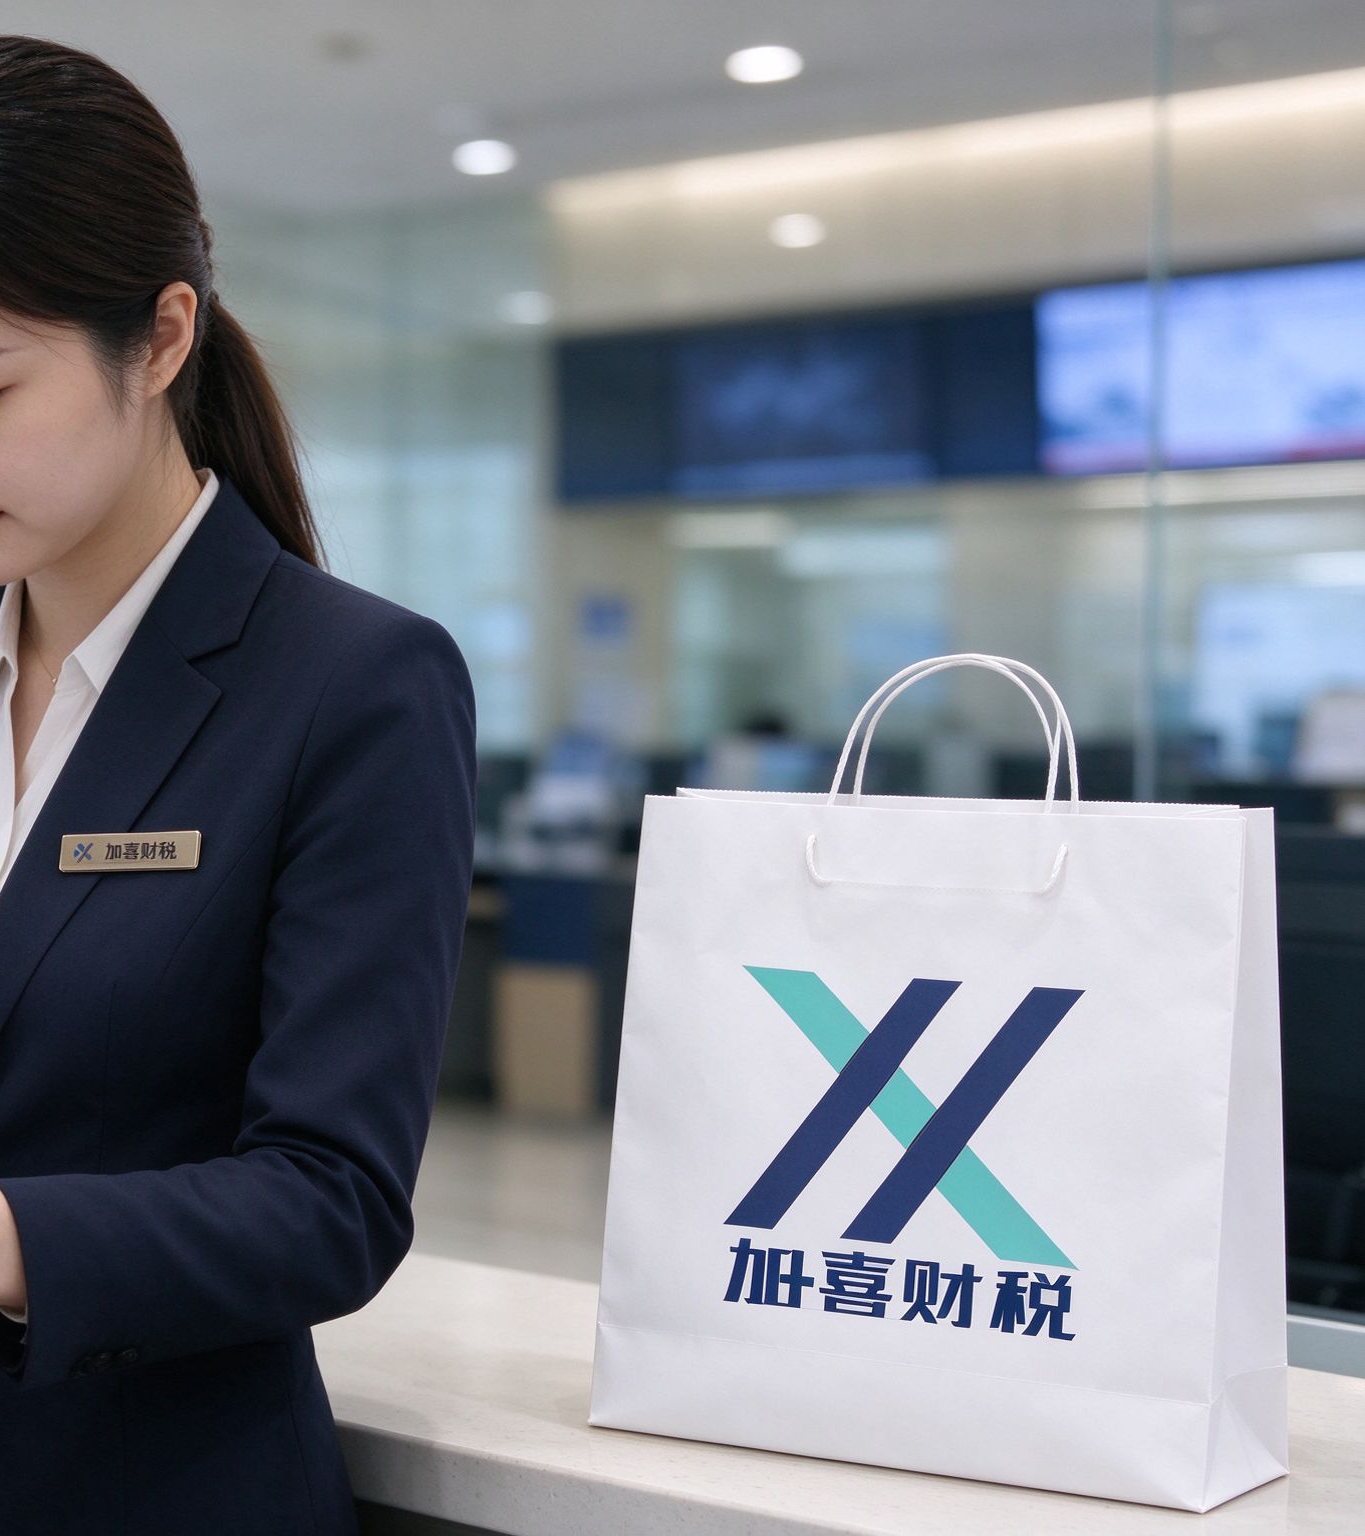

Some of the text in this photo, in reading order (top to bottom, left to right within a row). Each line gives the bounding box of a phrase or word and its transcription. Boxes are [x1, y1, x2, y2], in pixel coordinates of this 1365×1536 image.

[105, 841, 177, 860] 加喜财税
[723, 1237, 1076, 1341] 加喜财税
